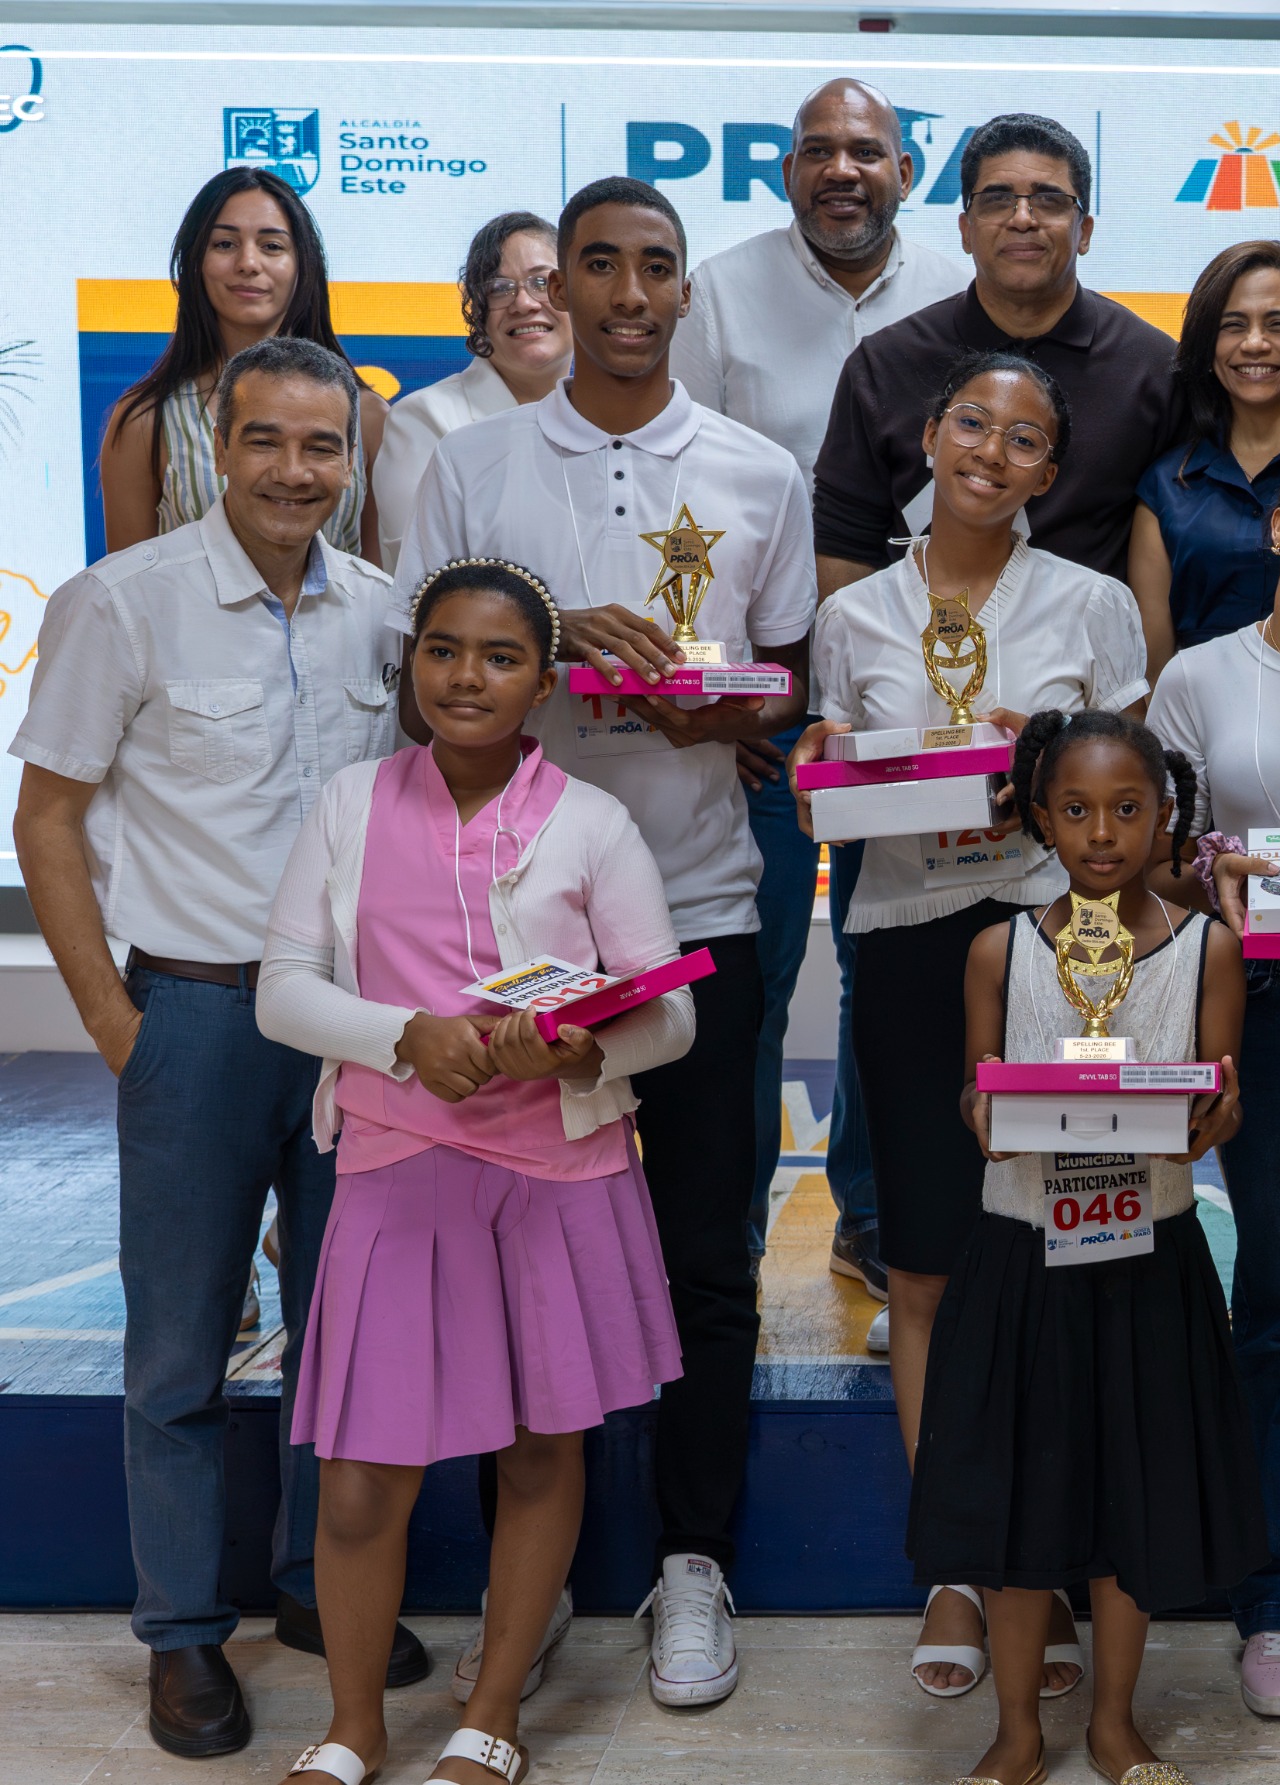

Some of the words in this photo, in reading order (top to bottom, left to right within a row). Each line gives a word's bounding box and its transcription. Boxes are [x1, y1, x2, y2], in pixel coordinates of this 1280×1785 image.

[340, 133, 429, 149] Santo
[341, 154, 487, 176] Domingo
[341, 176, 406, 193] Este
[670, 553, 699, 563] PROA
[938, 624, 964, 635] PROA
[610, 723, 642, 734] PROA
[957, 853, 989, 865] PROA
[1078, 927, 1110, 939] PROA
[494, 974, 539, 993] Spelling
[501, 971, 568, 996] MUNICIPAL
[501, 971, 594, 1005] PARTICIPANTE
[1058, 1153, 1133, 1169] MUNICIPAL
[1044, 1170, 1147, 1195] PARTICIPANTE
[1053, 1189, 1142, 1231] 046
[1080, 1232, 1116, 1245] PROA
